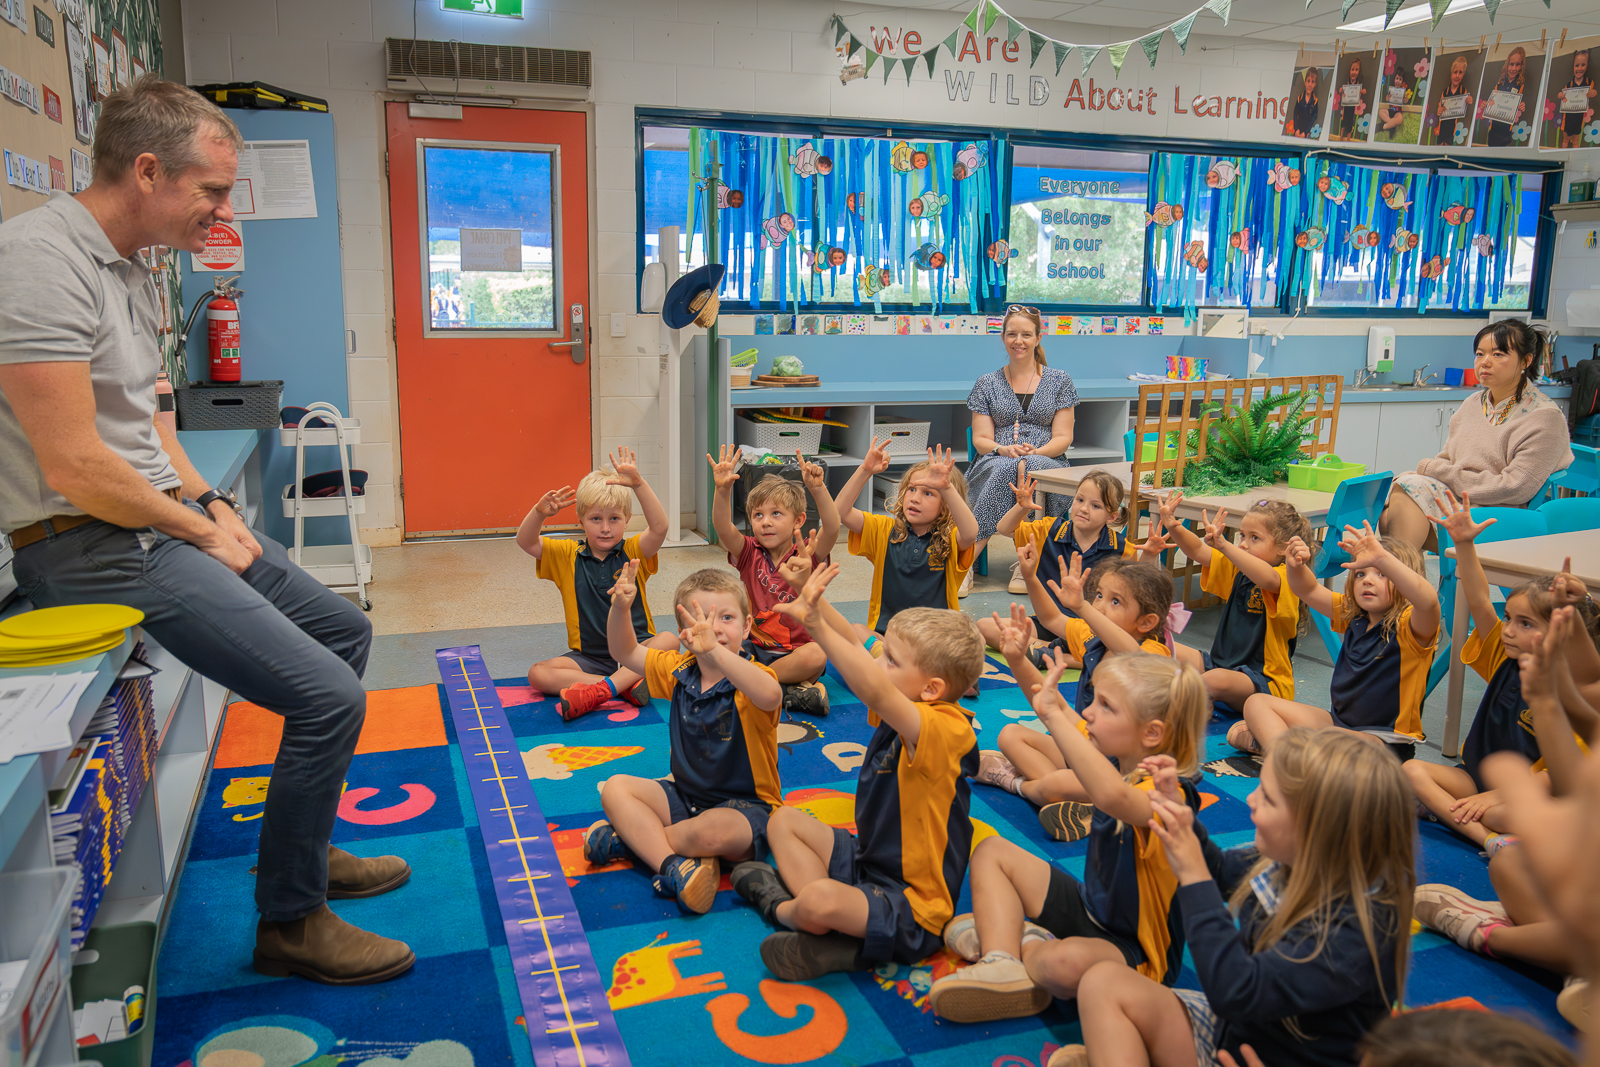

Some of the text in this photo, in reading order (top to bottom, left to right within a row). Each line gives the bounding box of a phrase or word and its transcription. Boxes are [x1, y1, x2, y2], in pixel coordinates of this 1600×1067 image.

[870, 26, 1019, 63] We Are
[944, 70, 1050, 106] WILD
[1064, 78, 1157, 115] About
[1039, 176, 1120, 198] Everyone
[1041, 208, 1111, 229] Belongs
[1055, 235, 1103, 251] in our
[1047, 262, 1105, 279] School
[705, 978, 849, 1064] G
